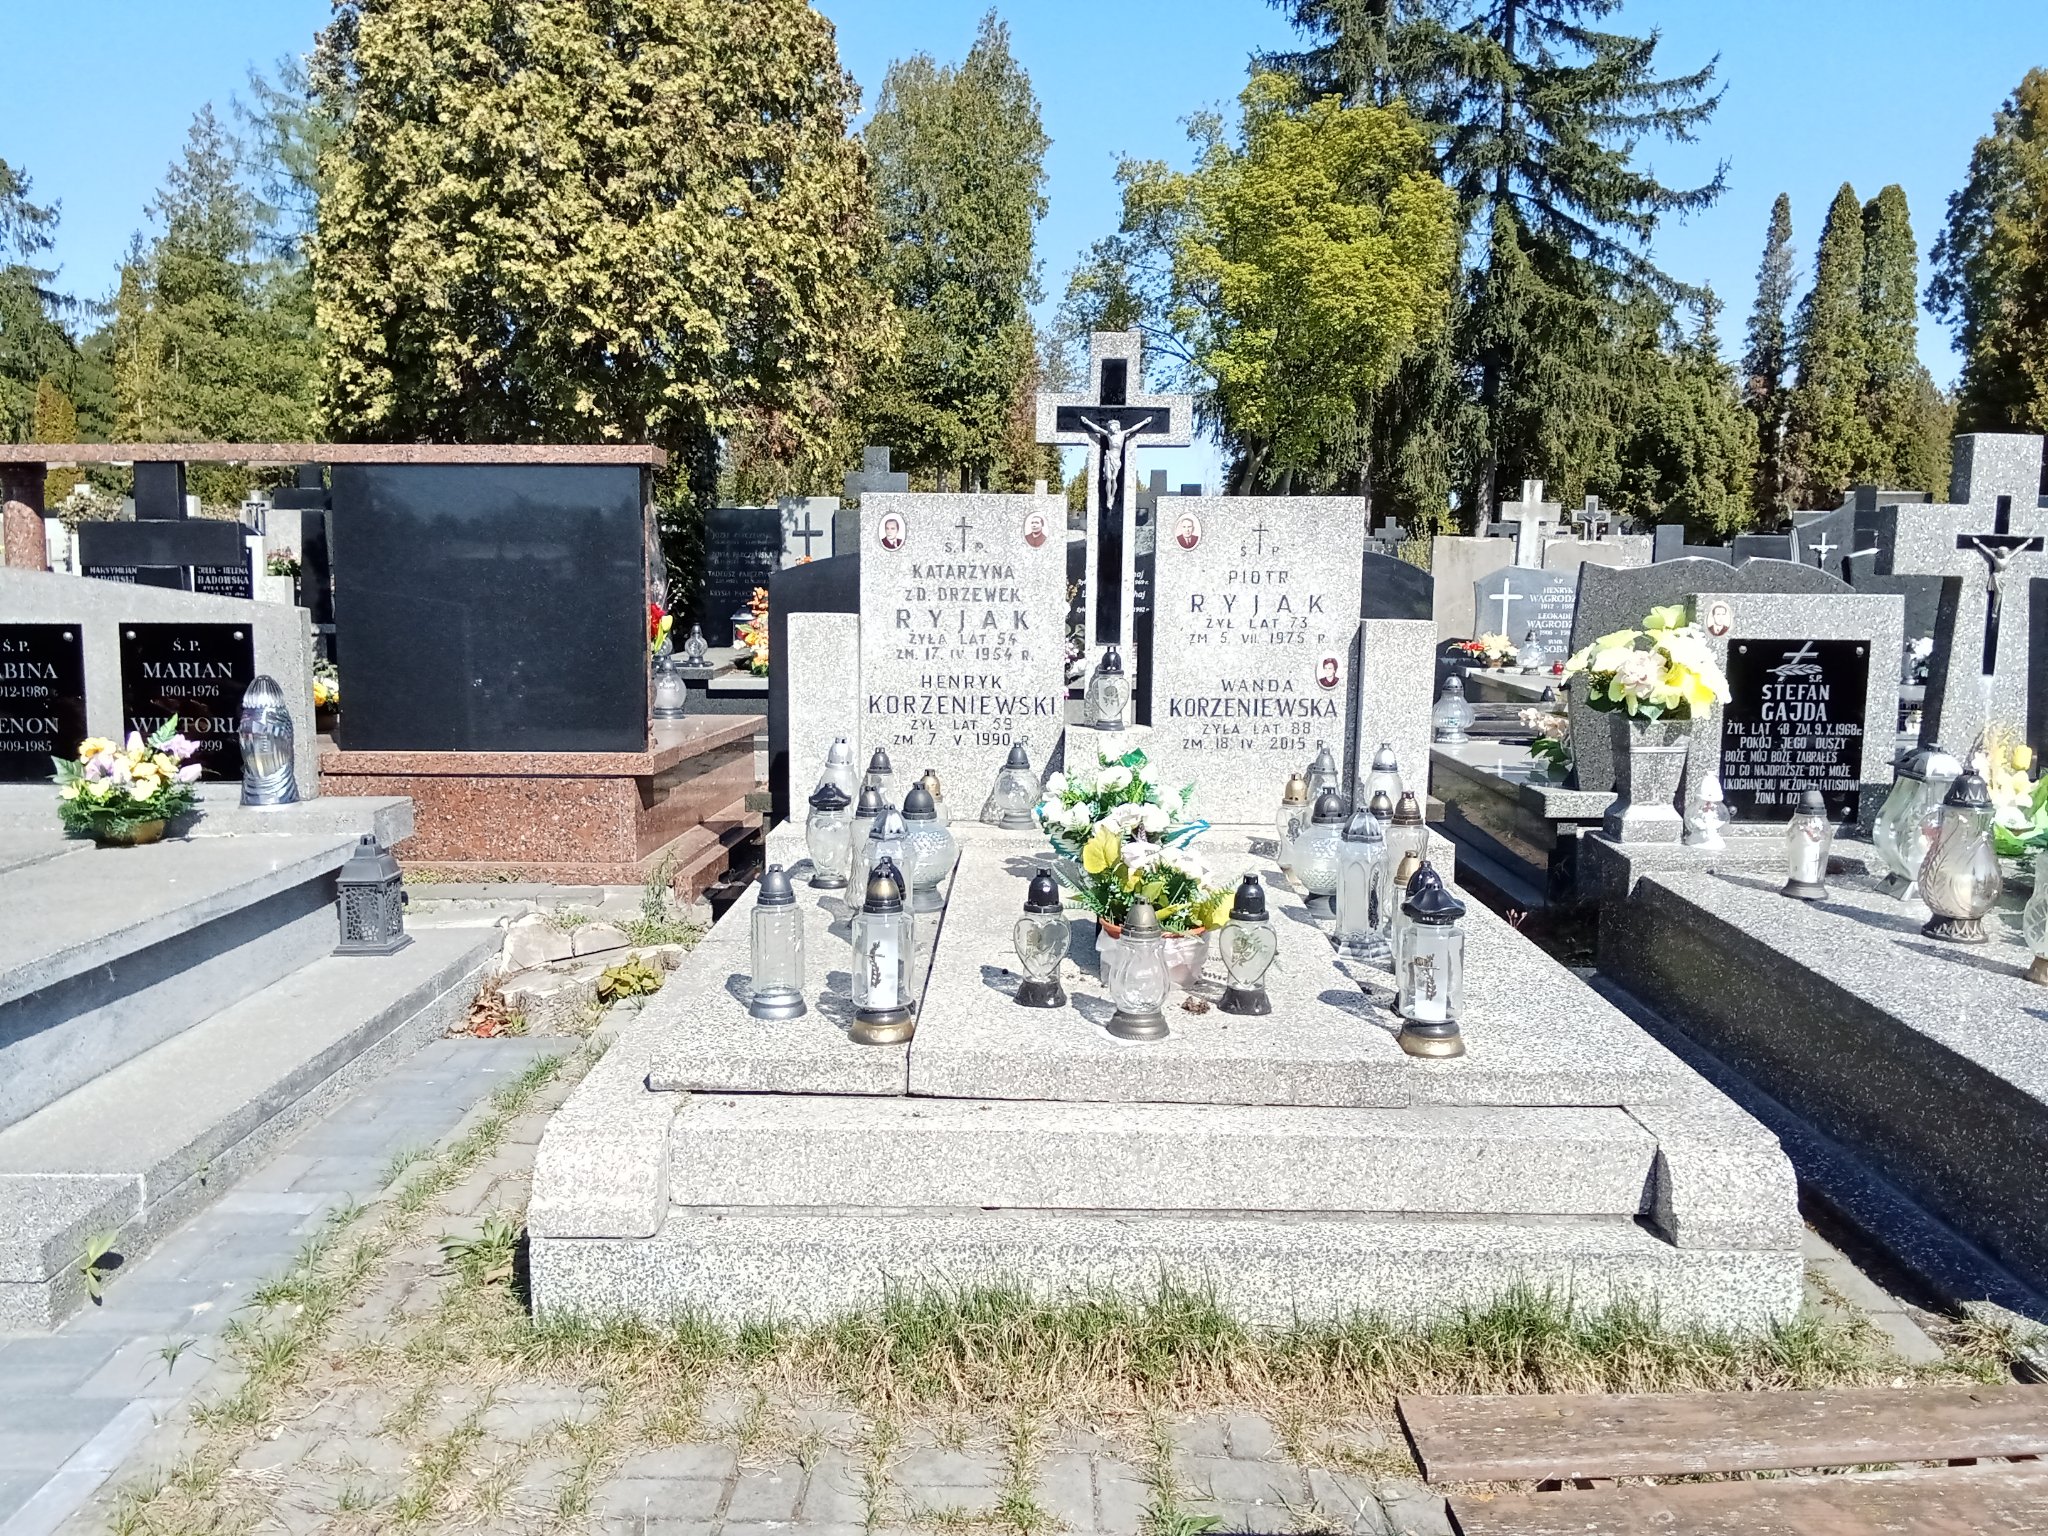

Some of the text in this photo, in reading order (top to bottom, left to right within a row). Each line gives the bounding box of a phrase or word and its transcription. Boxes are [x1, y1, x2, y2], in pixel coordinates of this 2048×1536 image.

[912, 564, 1015, 580] KATARZYNA
[1228, 570, 1288, 584] PIOTR
[938, 587, 1021, 602] DRZEWEK
[1249, 619, 1279, 629] LAT
[1290, 617, 1308, 629] 73
[960, 633, 987, 645] LAT
[997, 632, 1018, 646] 54
[1270, 631, 1305, 644] 1975
[2, 638, 30, 652] Ś. P.
[173, 638, 201, 652] Ś. P.
[976, 647, 1012, 660] 1954
[0, 662, 58, 679] BINA
[142, 662, 233, 679] MARIAN
[921, 675, 1002, 689] HENRYK
[1221, 679, 1293, 692] WANDA
[160, 685, 220, 697] 1901-1976
[1761, 684, 1830, 700] STEFAN
[869, 695, 1055, 716] KORZENIEWSKI
[1170, 697, 1337, 717] KORZENIEWSKA
[1761, 702, 1827, 721] GAJDA
[131, 717, 240, 733] WITORI
[953, 719, 978, 730] LAT
[993, 717, 1012, 731] 59
[1253, 724, 1280, 735] LAT
[1291, 722, 1311, 735] 88
[1727, 720, 1746, 735] ŻYŁ
[1751, 722, 1771, 735] LAT
[1777, 722, 1790, 735] 48
[1795, 722, 1812, 736] ZM.
[977, 733, 1011, 746] 1990
[1270, 737, 1306, 749] 2015
[1740, 735, 1847, 750] POKÓJ JEGO DUSZY
[1724, 749, 1746, 763] BOŻE
[1750, 749, 1767, 763] MÓJ
[1771, 749, 1792, 763] BOŻE
[1725, 764, 1735, 776] TO
[1740, 764, 1750, 776] CO
[1829, 763, 1851, 777] MOŻE
[1723, 778, 1776, 791] UKOCHANEMU
[1755, 790, 1776, 805] ŻONA
